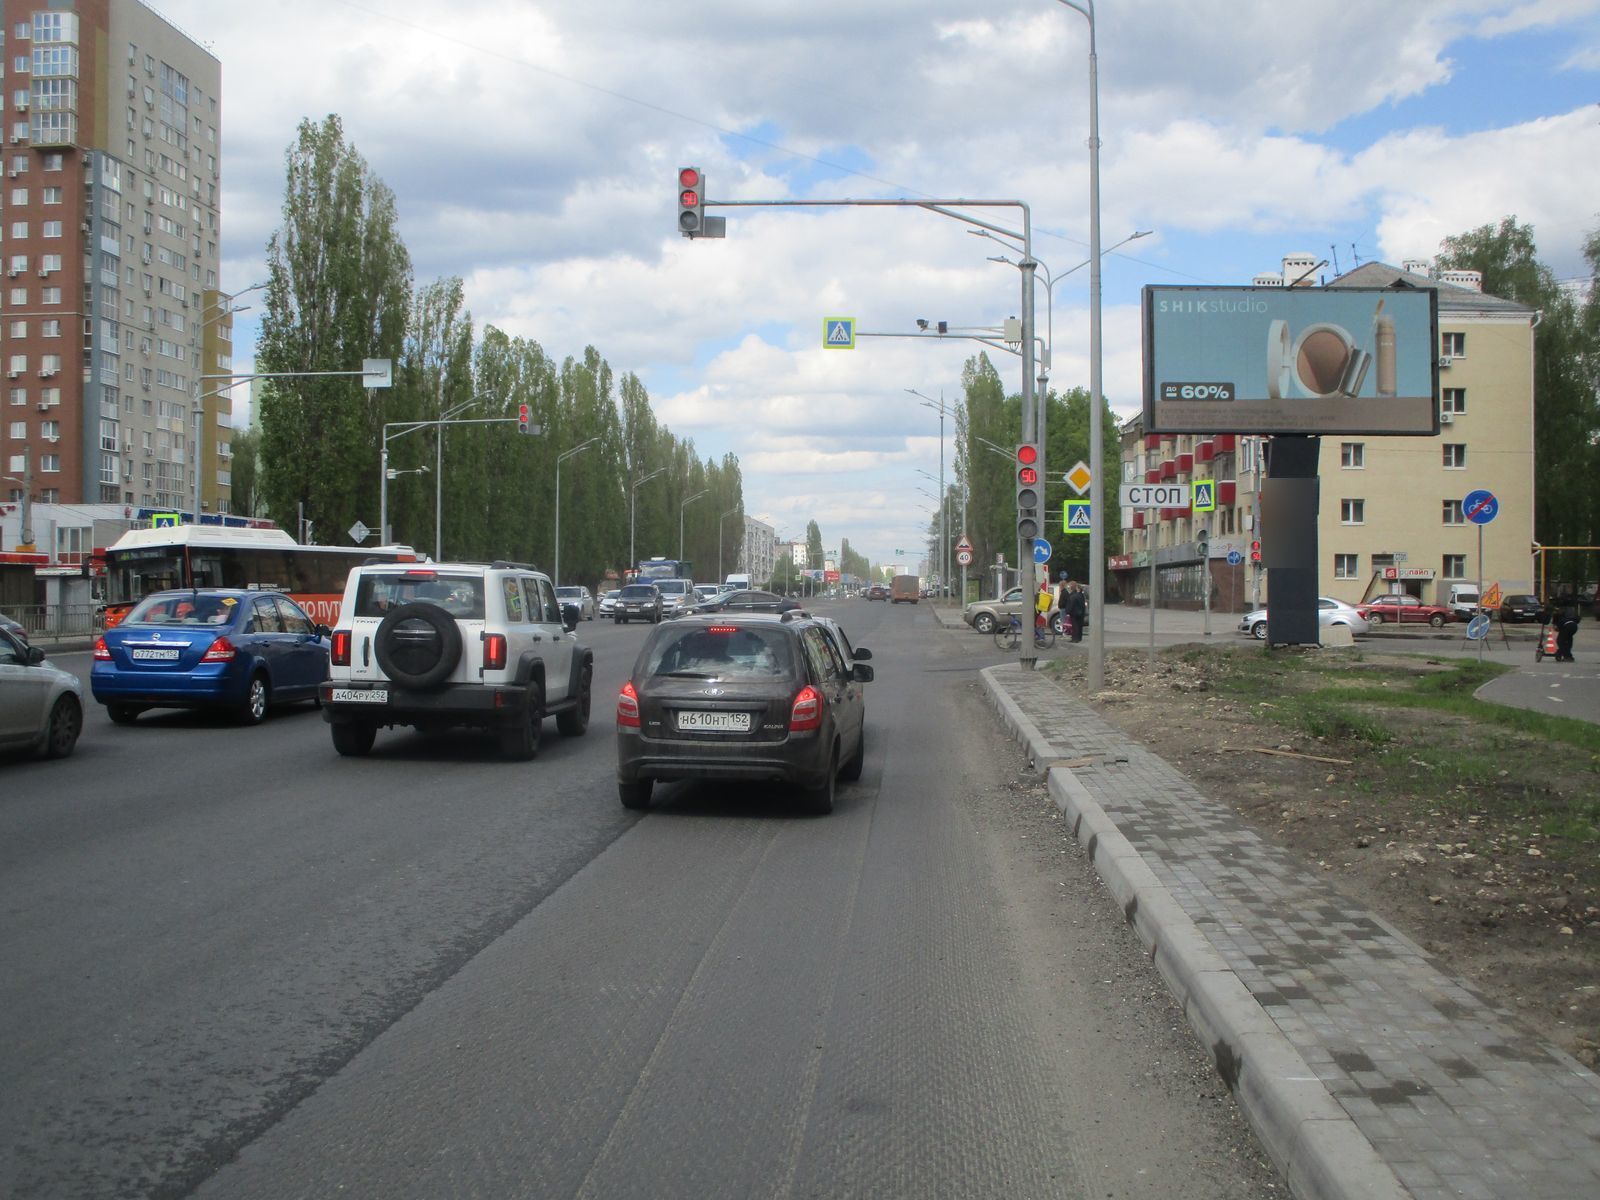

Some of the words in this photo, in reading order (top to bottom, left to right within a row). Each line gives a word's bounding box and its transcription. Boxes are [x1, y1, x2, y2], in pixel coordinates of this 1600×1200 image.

[1021, 470, 1036, 482] 50
[1129, 487, 1181, 504] СТОП
[317, 601, 342, 622] ПУТ
[682, 713, 727, 725] Н610НТ
[730, 714, 747, 723] 152
